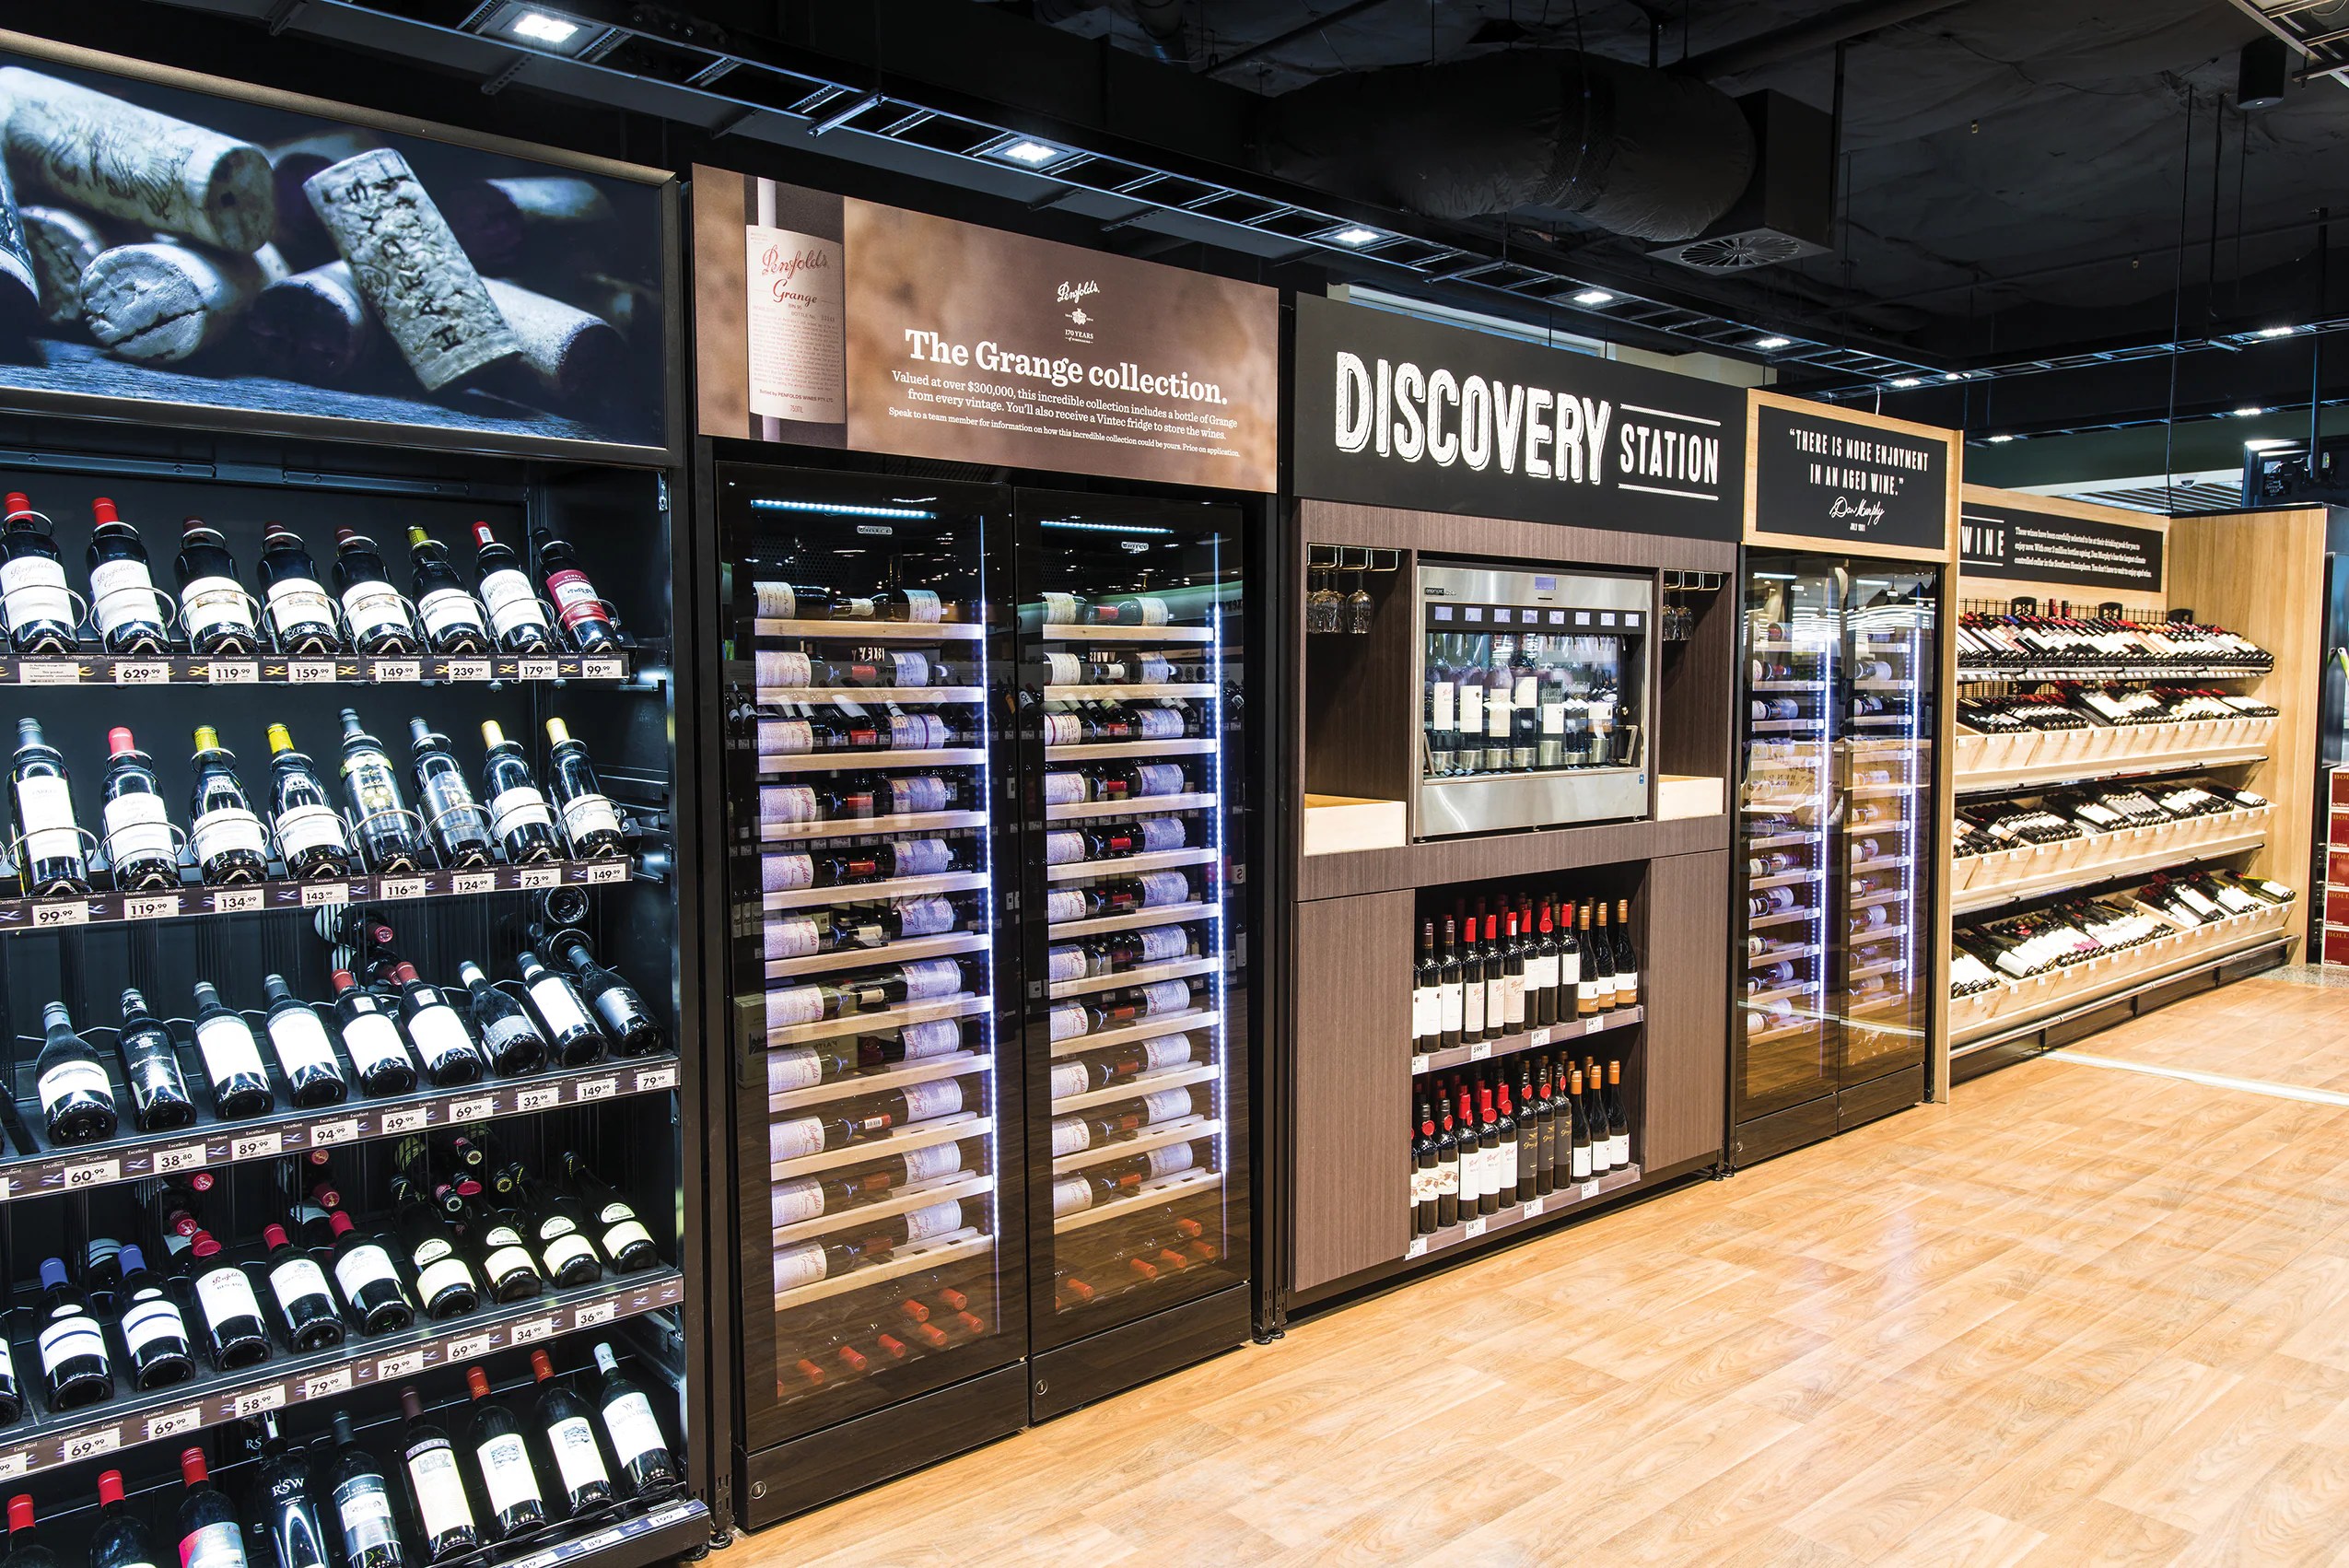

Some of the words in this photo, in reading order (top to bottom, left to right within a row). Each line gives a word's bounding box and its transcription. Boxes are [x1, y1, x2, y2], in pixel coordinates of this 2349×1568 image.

[772, 278, 818, 308] Grange
[1074, 330, 1093, 340] YEARS
[905, 328, 969, 367] The
[975, 340, 1083, 388] Grange
[1089, 361, 1228, 405] collection.
[892, 369, 929, 386] Valued
[931, 378, 941, 389] at
[943, 380, 966, 392] over
[967, 380, 1016, 400] $300,000,
[1017, 388, 1036, 401] this
[1037, 391, 1085, 407] incredible
[1086, 398, 1130, 413] collection
[1131, 404, 1167, 419] includes
[1168, 411, 1174, 419] a
[1174, 409, 1198, 423] bottle
[1199, 412, 1210, 424] of
[1209, 415, 1238, 429] Grange
[907, 388, 934, 403] from
[935, 395, 964, 408] every
[965, 396, 1005, 413] vintage.
[1006, 402, 1034, 415] You'll
[1034, 404, 1054, 417] also
[1055, 410, 1089, 422] receive
[1091, 415, 1095, 423] a
[1096, 413, 1127, 427] Vintec
[1127, 417, 1152, 432] fridge
[1153, 422, 1163, 432] to
[1163, 424, 1186, 435] store
[1186, 425, 1199, 437] the
[1201, 427, 1227, 440] wines.
[1336, 351, 1611, 486] DISCOVERY
[1619, 424, 1719, 485] STATION
[888, 406, 912, 418] Speak
[913, 411, 922, 419] to
[928, 413, 948, 423] team
[948, 415, 978, 427] member
[979, 418, 990, 428] for
[990, 420, 1034, 433] information
[1034, 426, 1043, 434] on
[1044, 426, 1058, 436] how
[1058, 427, 1072, 438] this
[1072, 429, 1105, 442] incredible
[1105, 434, 1138, 445] collection
[1138, 438, 1155, 448] could
[1155, 439, 1163, 449] be
[1163, 442, 1182, 451] yours.
[1183, 443, 1198, 452] Price
[1208, 446, 1241, 458] application.
[1832, 436, 1842, 458] IS
[1846, 439, 1872, 462] MORE
[1876, 444, 1929, 472] ENJOYMENT
[1810, 463, 1821, 485] IN
[1825, 465, 1839, 487] AN
[1841, 469, 1866, 492] AGED
[1960, 525, 2004, 556] WINE
[123, 669, 160, 679] 629.99
[216, 668, 250, 678] 119.99
[296, 668, 329, 678] 159.99
[382, 668, 414, 677] 149.99
[453, 667, 483, 676] 239.99
[524, 666, 553, 674] 179.99
[587, 666, 611, 674] 99.99
[525, 876, 549, 886] 73.99
[593, 870, 620, 880] 149.99
[388, 885, 418, 895] 116.99
[458, 880, 487, 891] 124.99
[307, 891, 333, 900] 143.99
[221, 896, 257, 908] 134.99
[131, 904, 168, 915] 119.99
[39, 910, 73, 922] 99.99
[643, 1075, 665, 1087] 79.99
[582, 1084, 610, 1096] 149.99
[523, 1094, 548, 1106] 32.99
[456, 1106, 482, 1117] 69.99
[387, 1117, 415, 1129] 49.99
[207, 1134, 228, 1142] Excellent
[317, 1128, 345, 1141] 94.99
[239, 1141, 269, 1154] 89.99
[161, 1153, 193, 1168] 38.80
[71, 1168, 104, 1183] 60.99
[516, 1316, 533, 1325] Excellent
[580, 1311, 603, 1324] 36.99
[517, 1327, 542, 1340] 34.99
[420, 1340, 438, 1349] Excellent
[452, 1343, 478, 1357] 69.99
[383, 1361, 410, 1375] 79.99
[296, 1372, 316, 1381] Excellent
[310, 1378, 339, 1395] 79.99
[182, 1399, 204, 1410] Excellent
[242, 1396, 272, 1412] 58.99
[101, 1421, 123, 1430] Excellent
[155, 1418, 186, 1434] 69.99
[71, 1439, 105, 1456] 69.99
[271, 1478, 305, 1497] RSW
